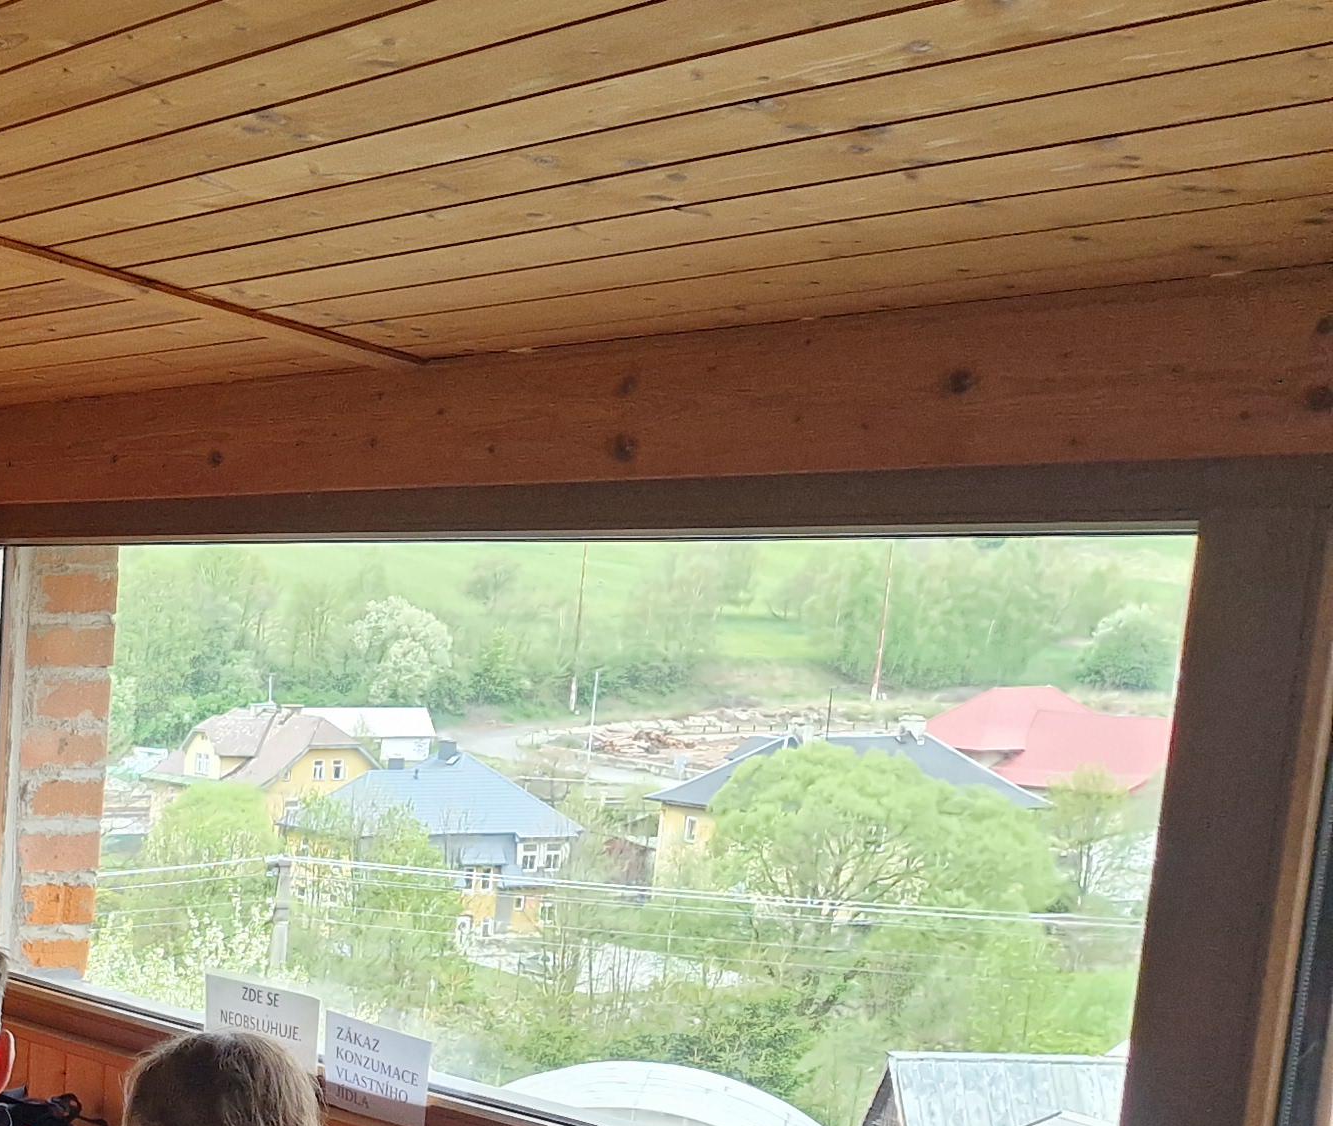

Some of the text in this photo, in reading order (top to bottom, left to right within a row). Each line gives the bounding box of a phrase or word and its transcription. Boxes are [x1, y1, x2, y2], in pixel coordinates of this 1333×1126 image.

[241, 986, 281, 1008] ZDE SE
[220, 1008, 302, 1042] NEOBSLUHUJE.
[335, 1025, 380, 1053] ZÁKAZ
[335, 1045, 420, 1087] KONZUMACE
[335, 1065, 410, 1104] VLASTNÍHO
[335, 1083, 370, 1109] JÍDLA
